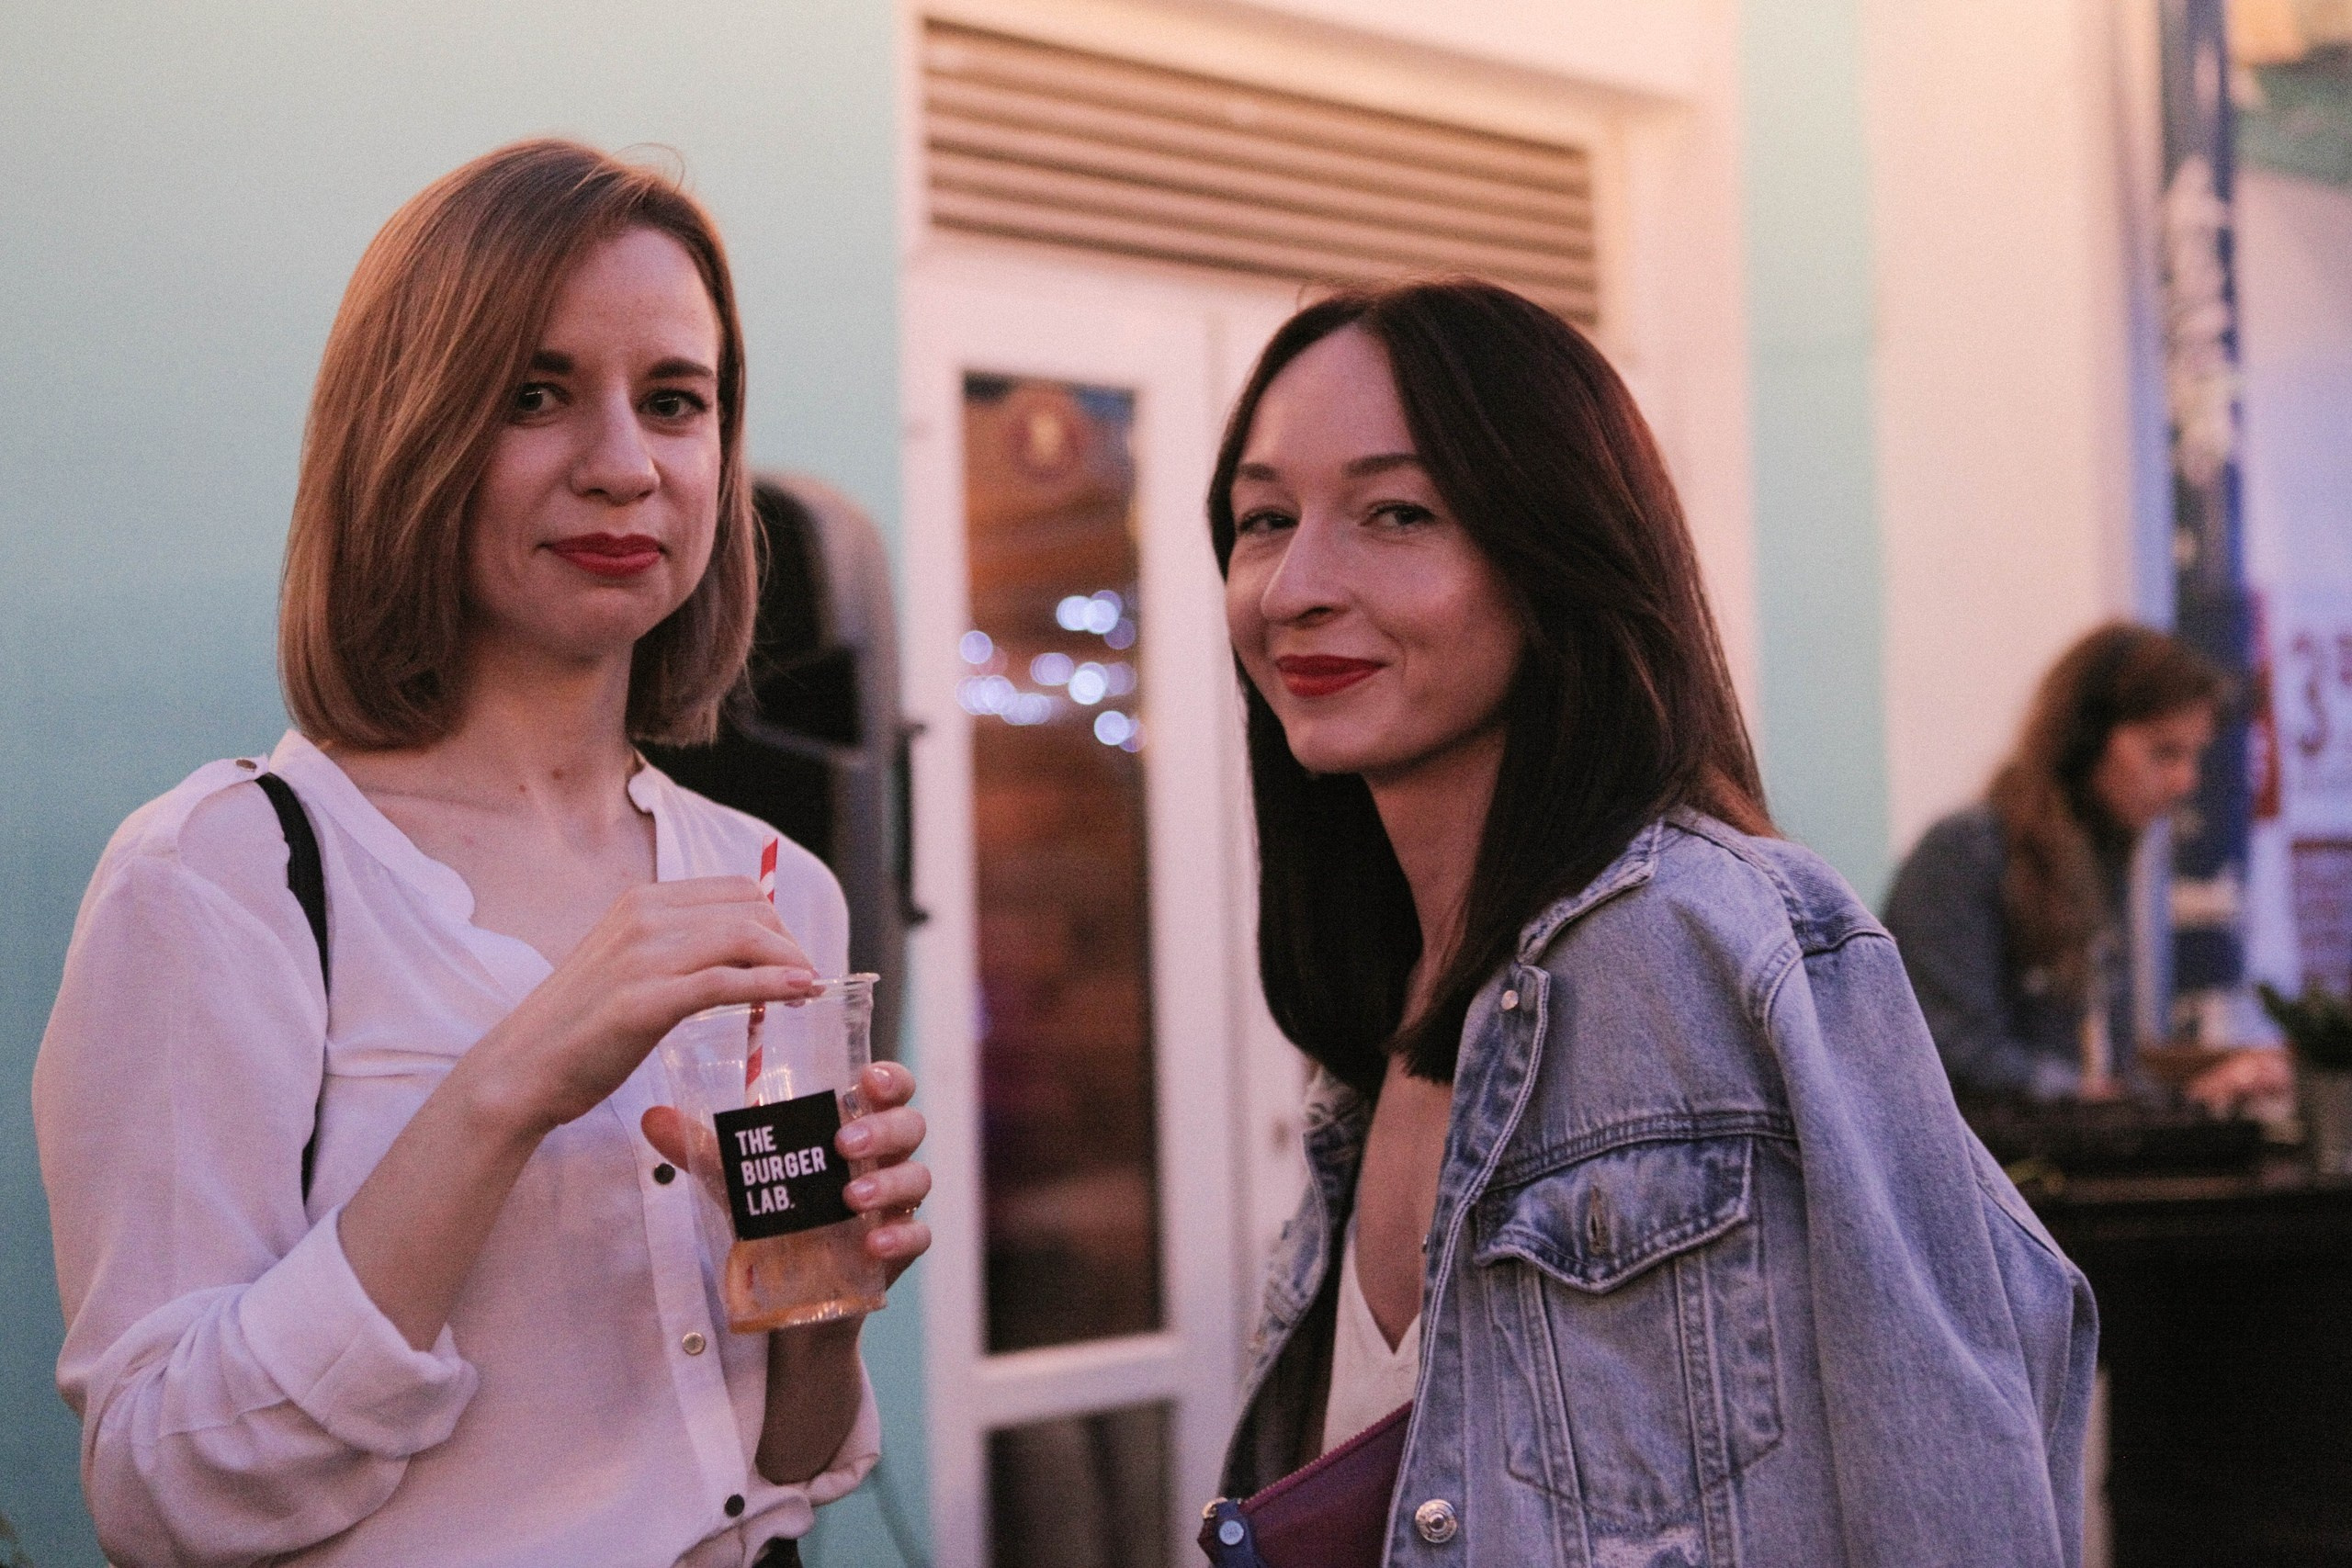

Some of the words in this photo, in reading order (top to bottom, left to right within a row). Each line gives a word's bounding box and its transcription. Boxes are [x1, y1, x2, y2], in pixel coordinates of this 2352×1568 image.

[735, 1126, 777, 1156] THE
[741, 1146, 827, 1186] BURGER
[747, 1186, 796, 1216] LAB.
